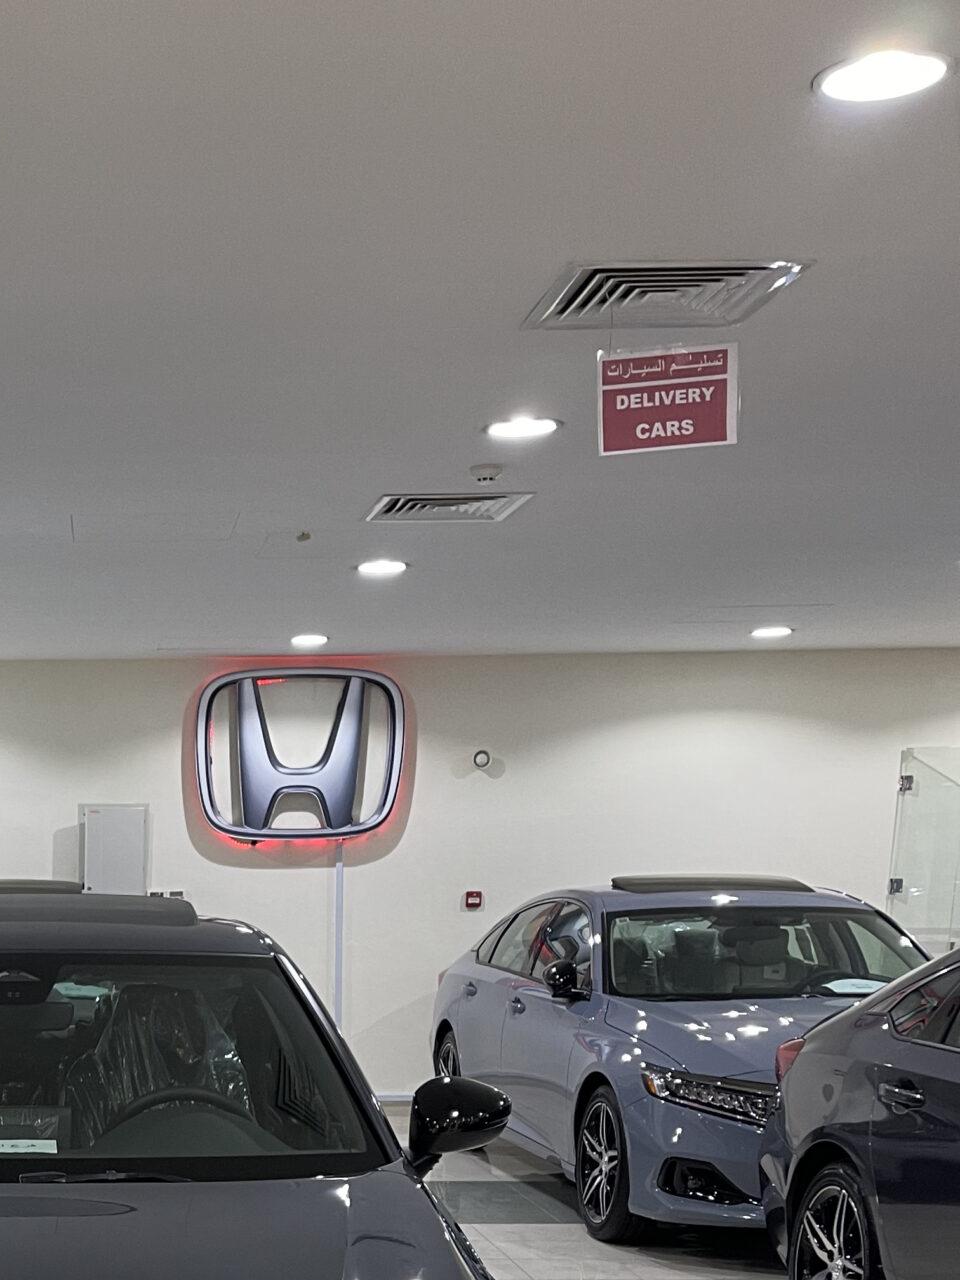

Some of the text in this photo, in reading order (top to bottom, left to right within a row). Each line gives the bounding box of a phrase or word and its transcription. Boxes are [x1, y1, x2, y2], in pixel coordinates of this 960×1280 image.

[606, 353, 724, 379] تسليم السيارات
[616, 386, 716, 410] DELIVERY
[635, 419, 694, 440] CARS
